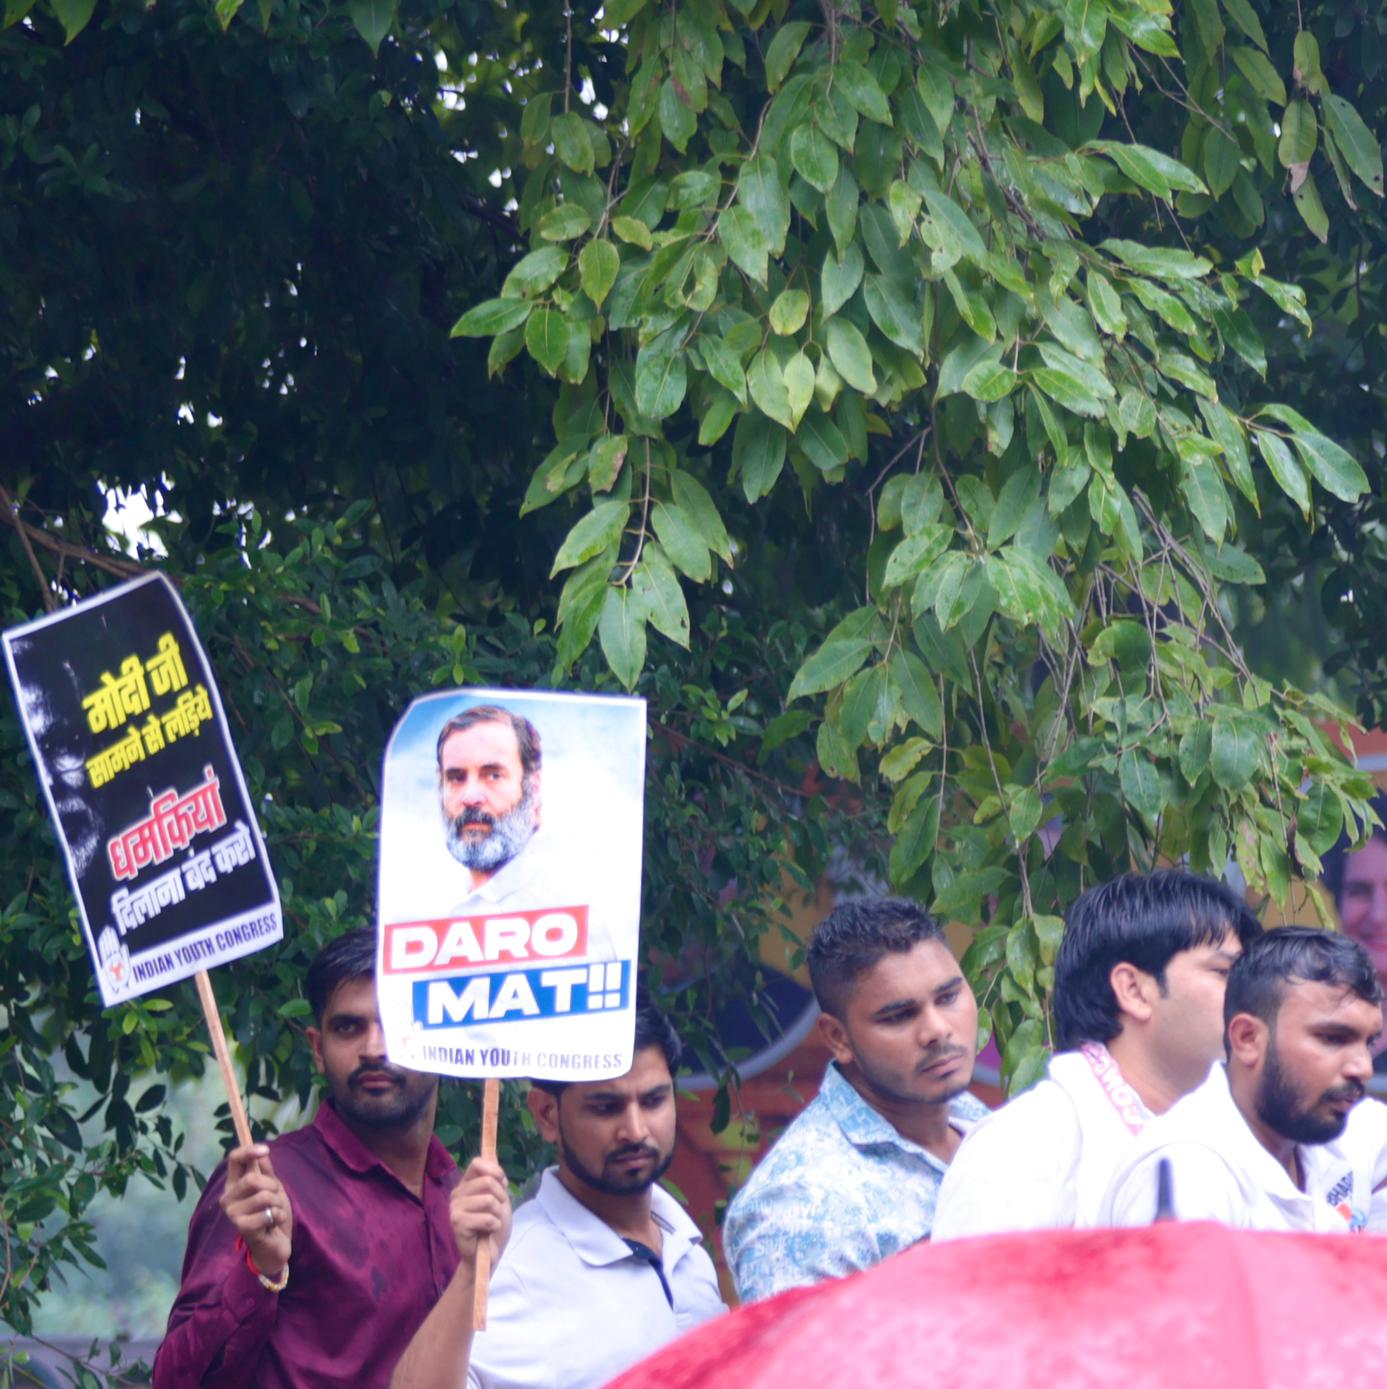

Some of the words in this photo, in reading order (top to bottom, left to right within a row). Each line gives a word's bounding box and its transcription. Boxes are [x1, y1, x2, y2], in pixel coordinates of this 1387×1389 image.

[82, 653, 151, 734] मोदी
[146, 631, 188, 696] जी
[85, 725, 146, 789] सामने
[141, 713, 165, 755] से
[107, 764, 227, 881] धमकियां
[111, 885, 186, 936] दिलाना
[391, 912, 578, 969] DARO
[132, 953, 174, 983] INDIAN
[174, 938, 215, 967] YOUTH
[215, 913, 278, 951] CONGRESS
[428, 962, 622, 1024] MAT!!
[423, 1045, 475, 1066] INDIAN
[480, 1047, 531, 1067] YOUTH
[537, 1052, 623, 1069] CONGRESS
